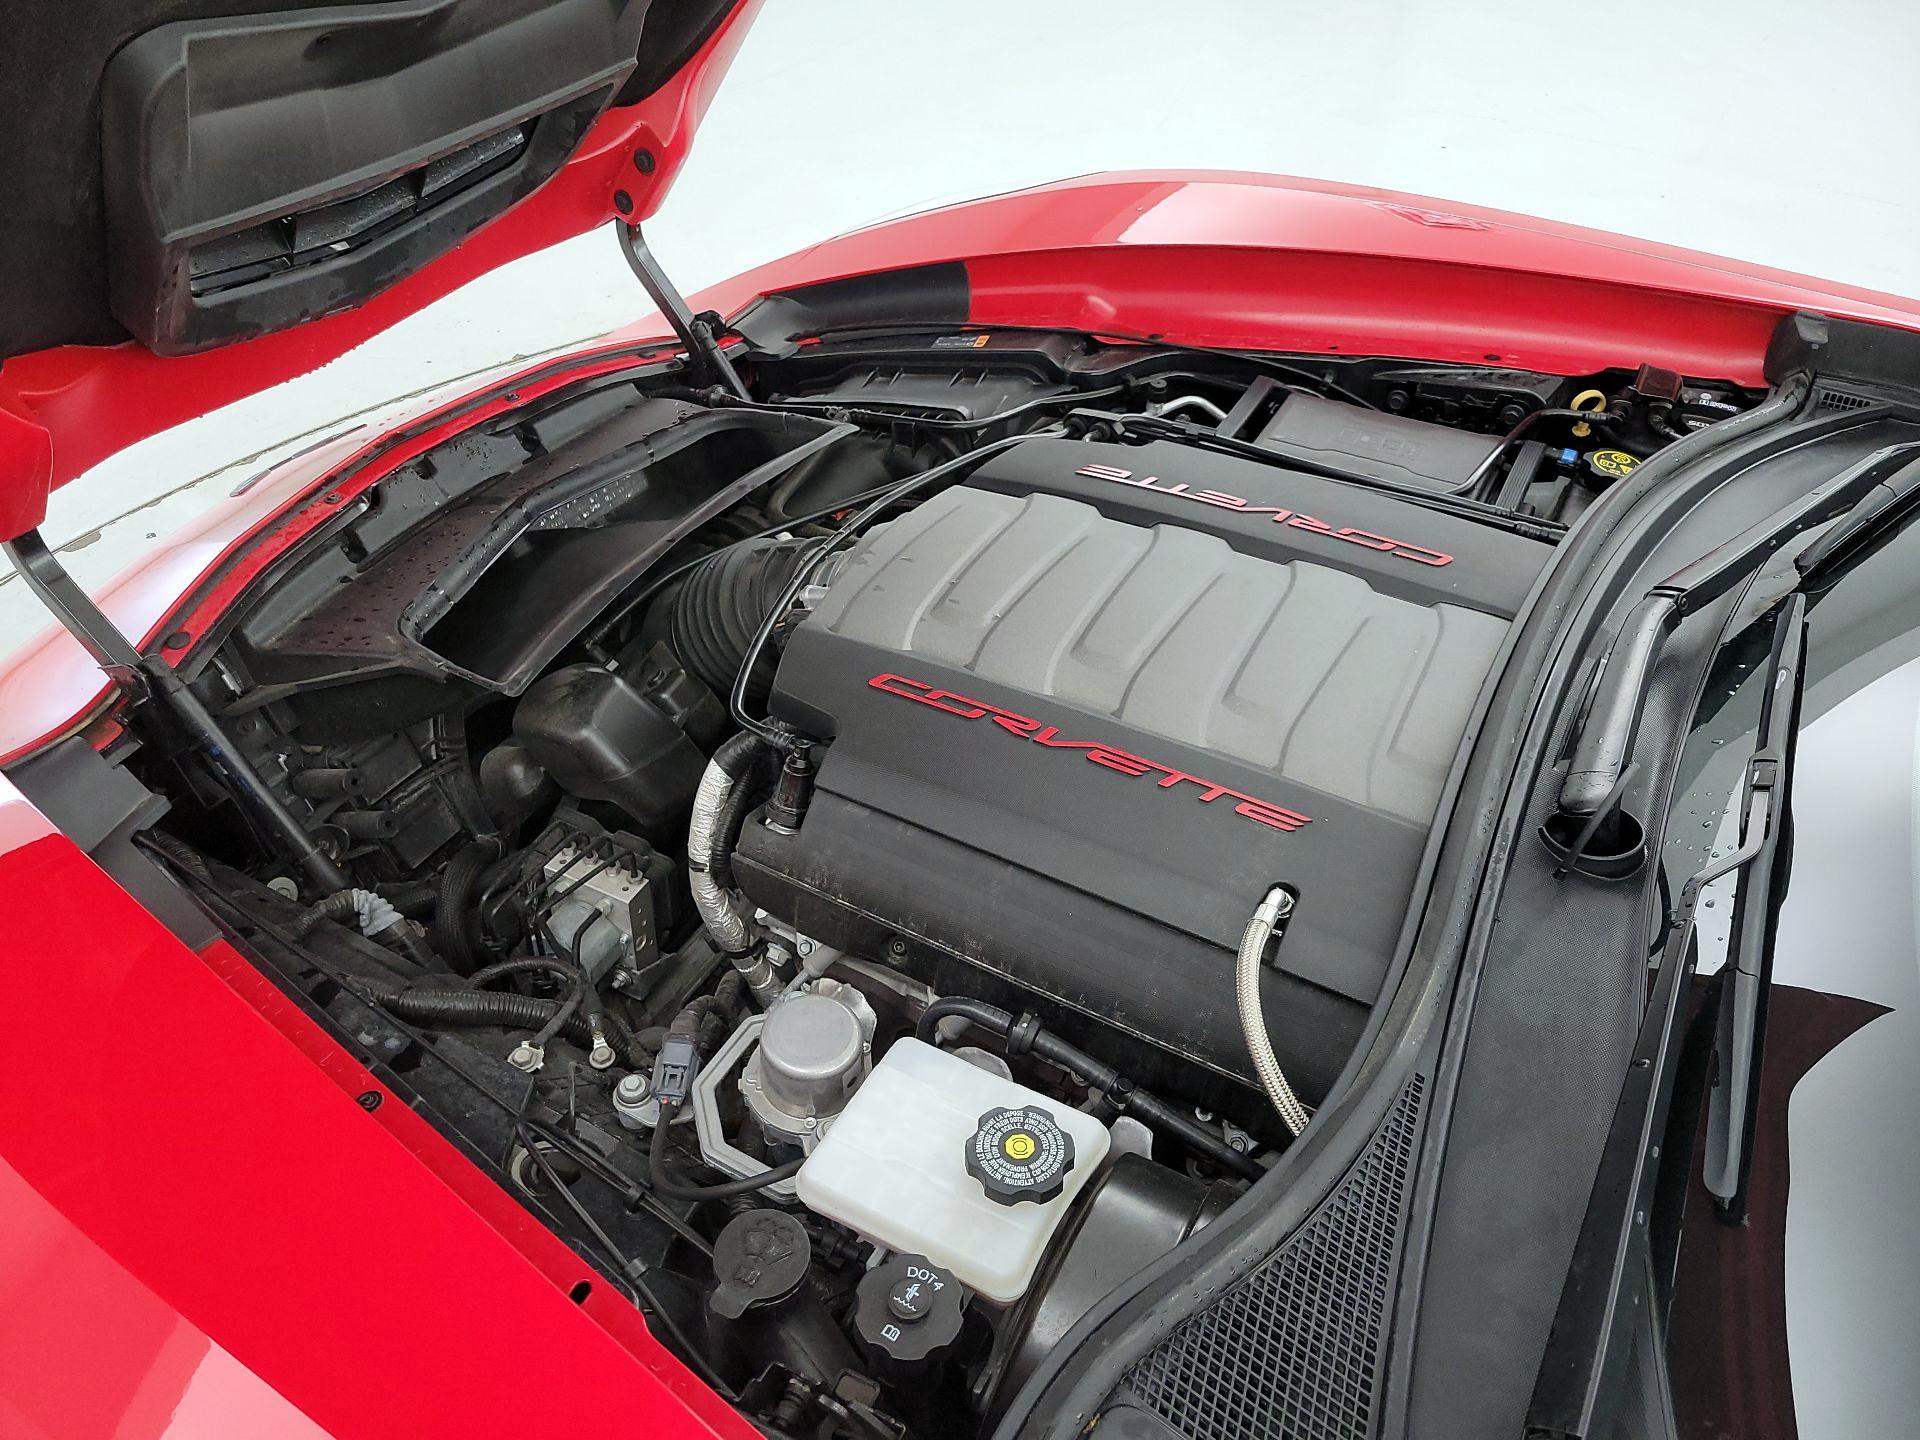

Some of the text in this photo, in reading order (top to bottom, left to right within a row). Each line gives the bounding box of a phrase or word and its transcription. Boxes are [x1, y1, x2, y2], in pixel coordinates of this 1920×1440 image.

[1075, 464, 1453, 566] CORVETTE
[868, 673, 1313, 832] CORVETTE
[1025, 1118, 1038, 1126] ONLY
[1037, 1123, 1048, 1132] USE
